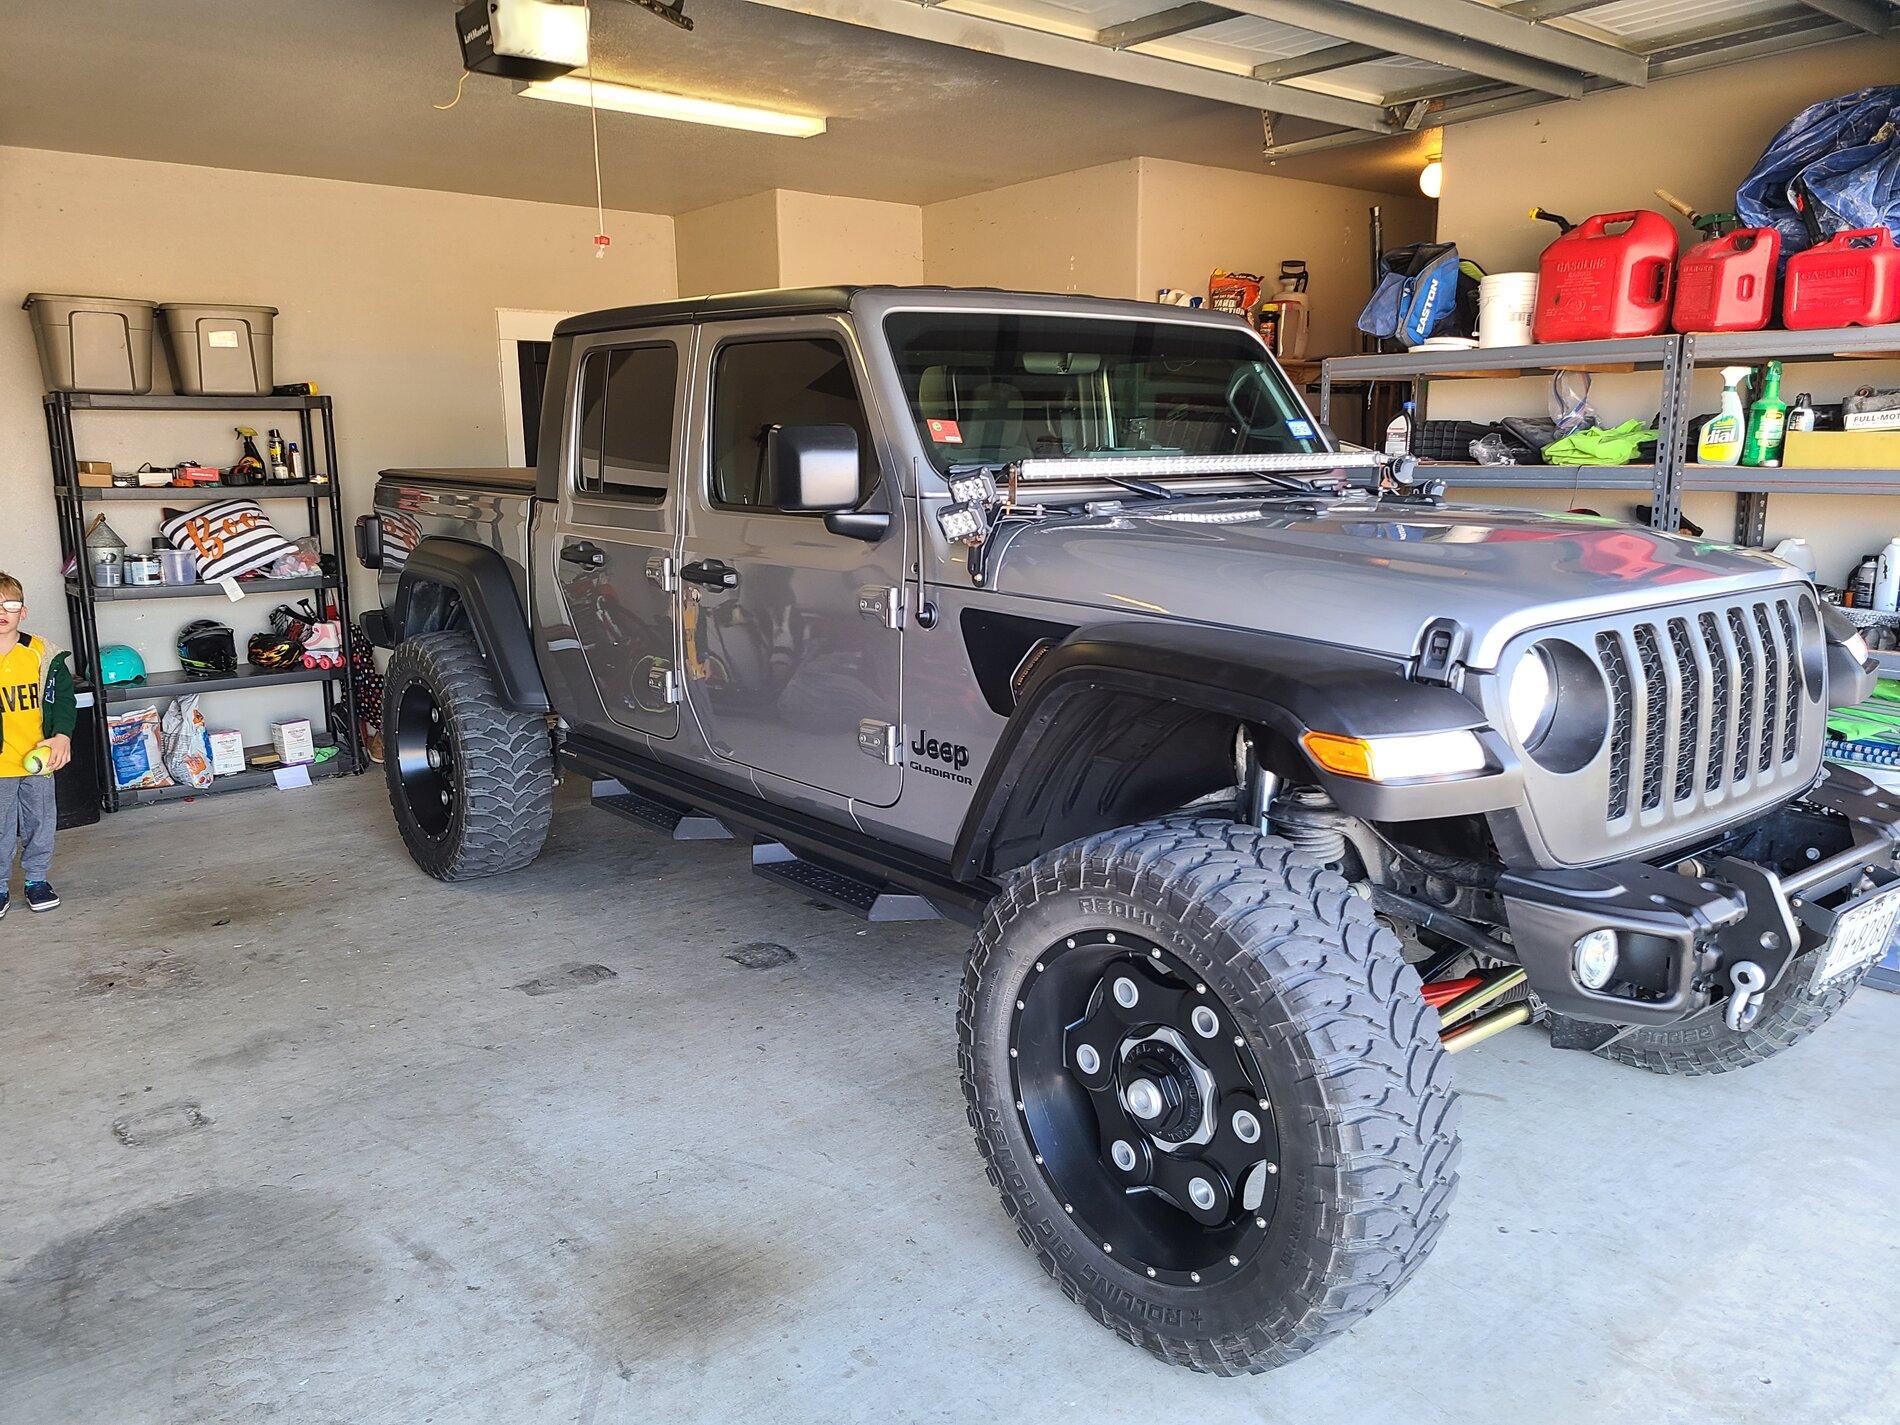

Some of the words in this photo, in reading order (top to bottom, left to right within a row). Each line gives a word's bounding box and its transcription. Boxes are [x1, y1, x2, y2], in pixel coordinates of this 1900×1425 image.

[1214, 299, 1236, 308] YARD
[1416, 278, 1439, 335] EASTON
[1705, 428, 1737, 445] dial
[185, 513, 260, 560] Boo
[911, 729, 970, 771] Jeep
[909, 760, 973, 786] GLADIATOR
[1036, 1217, 1080, 1264] BIG
[1080, 1263, 1183, 1328] ROLLING
